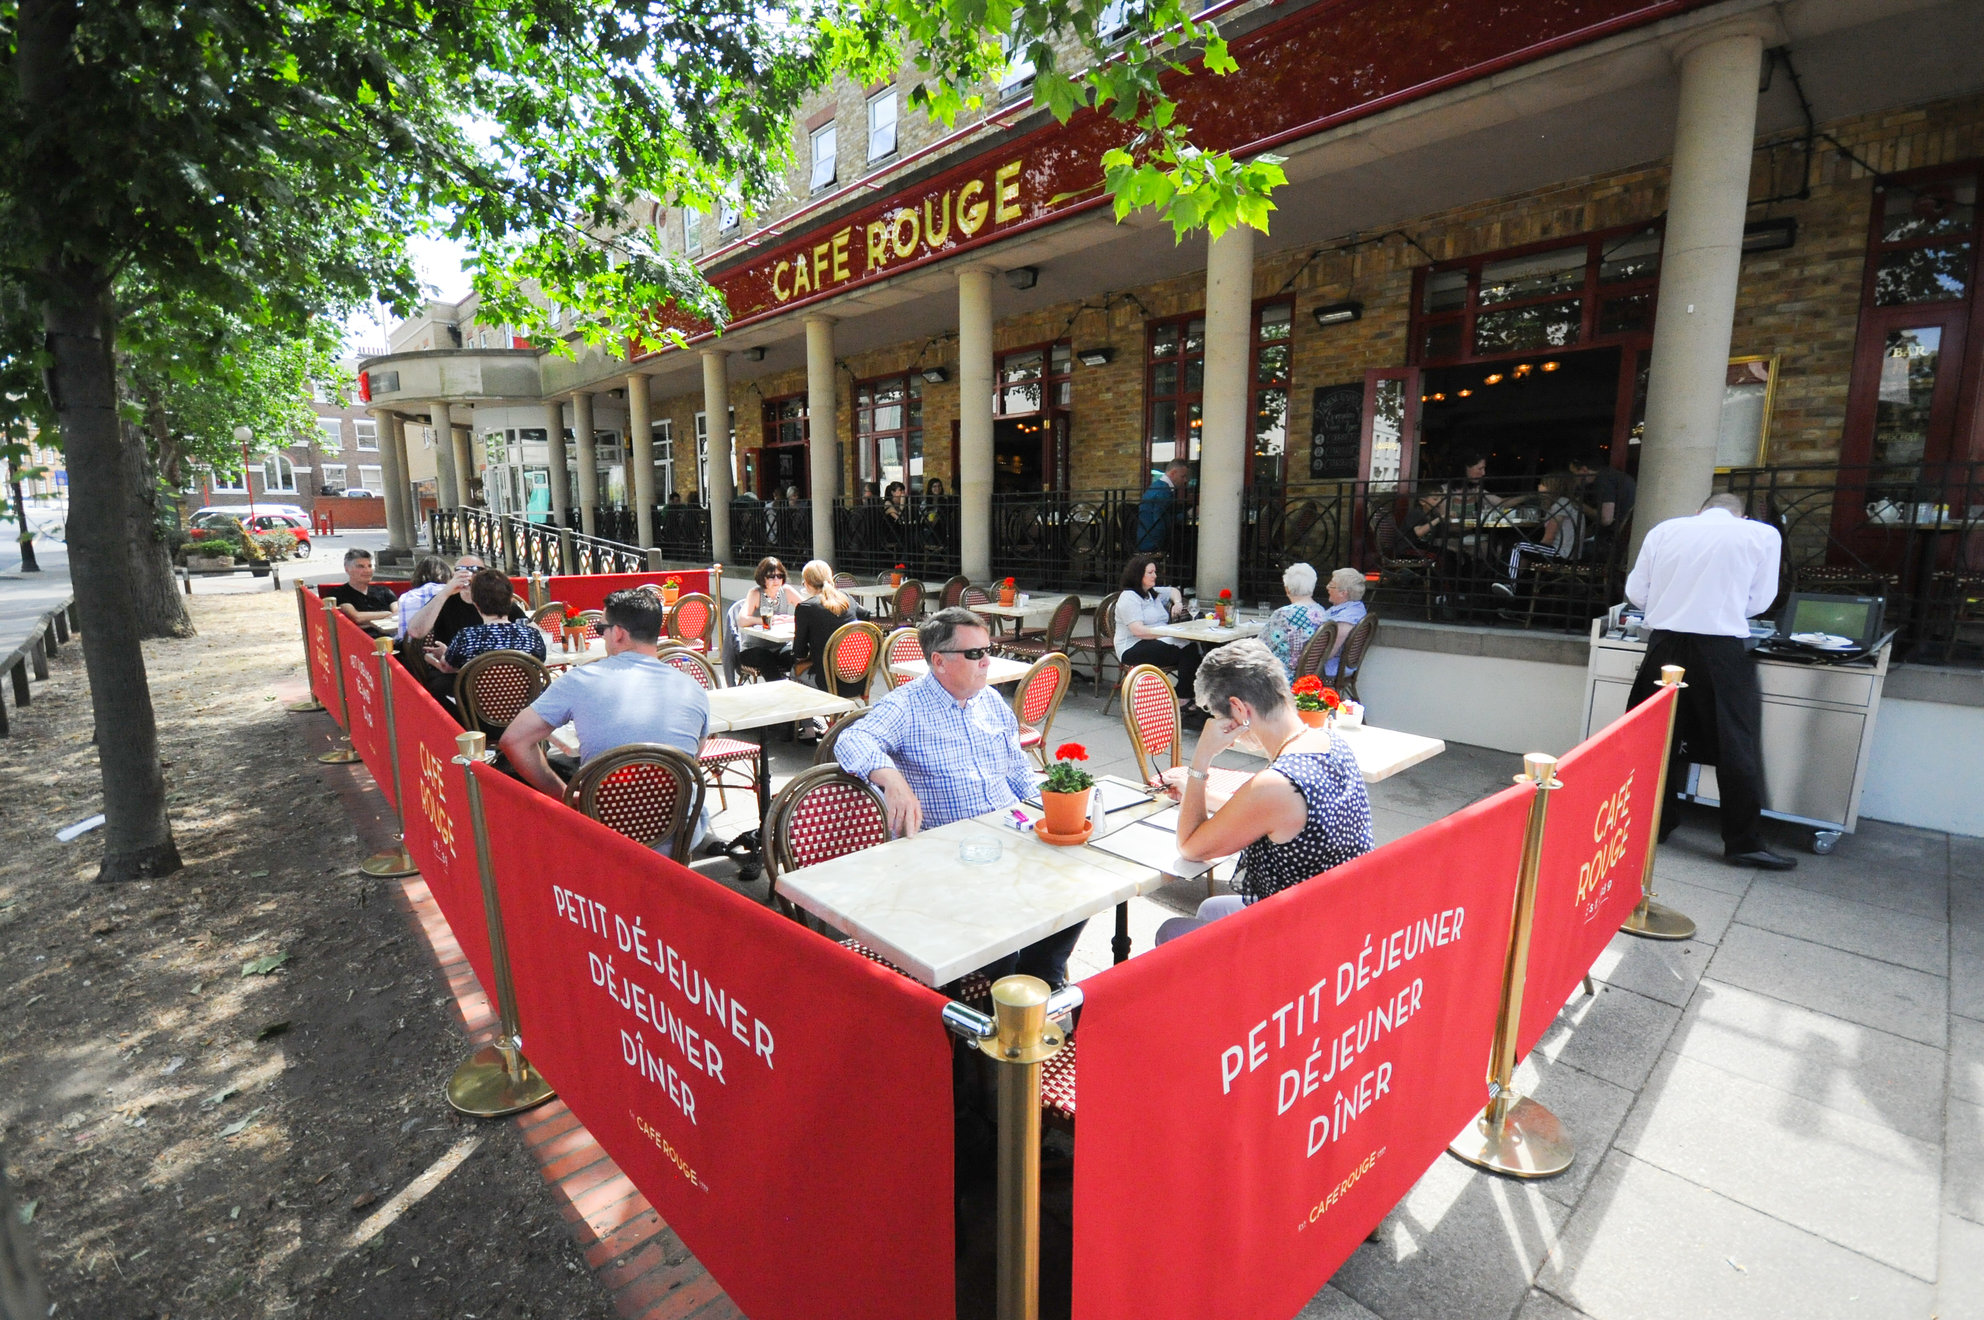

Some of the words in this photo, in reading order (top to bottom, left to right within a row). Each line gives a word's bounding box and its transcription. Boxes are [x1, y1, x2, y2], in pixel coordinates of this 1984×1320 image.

[772, 225, 852, 302] CAFÉ
[866, 159, 1022, 270] ROUGE
[1892, 345, 1929, 358] BAR
[419, 740, 447, 803] CAFÉ
[419, 777, 457, 859] ROUGE
[1593, 768, 1636, 843] CAFÉ
[1575, 817, 1632, 907] ROUGE
[553, 885, 607, 939] PETIT
[615, 915, 775, 1070] DÉJEUNER
[588, 951, 726, 1085] DÉJEUNER
[1221, 977, 1327, 1096] PETIT
[1336, 906, 1465, 1006] DÉJEUNER
[620, 1028, 697, 1126] DÎNER
[1277, 977, 1424, 1116] DÉJEUNER
[1306, 1061, 1393, 1158] DÎNER
[662, 1139, 699, 1187] ROUGE
[1340, 1151, 1377, 1197] ROUGE
